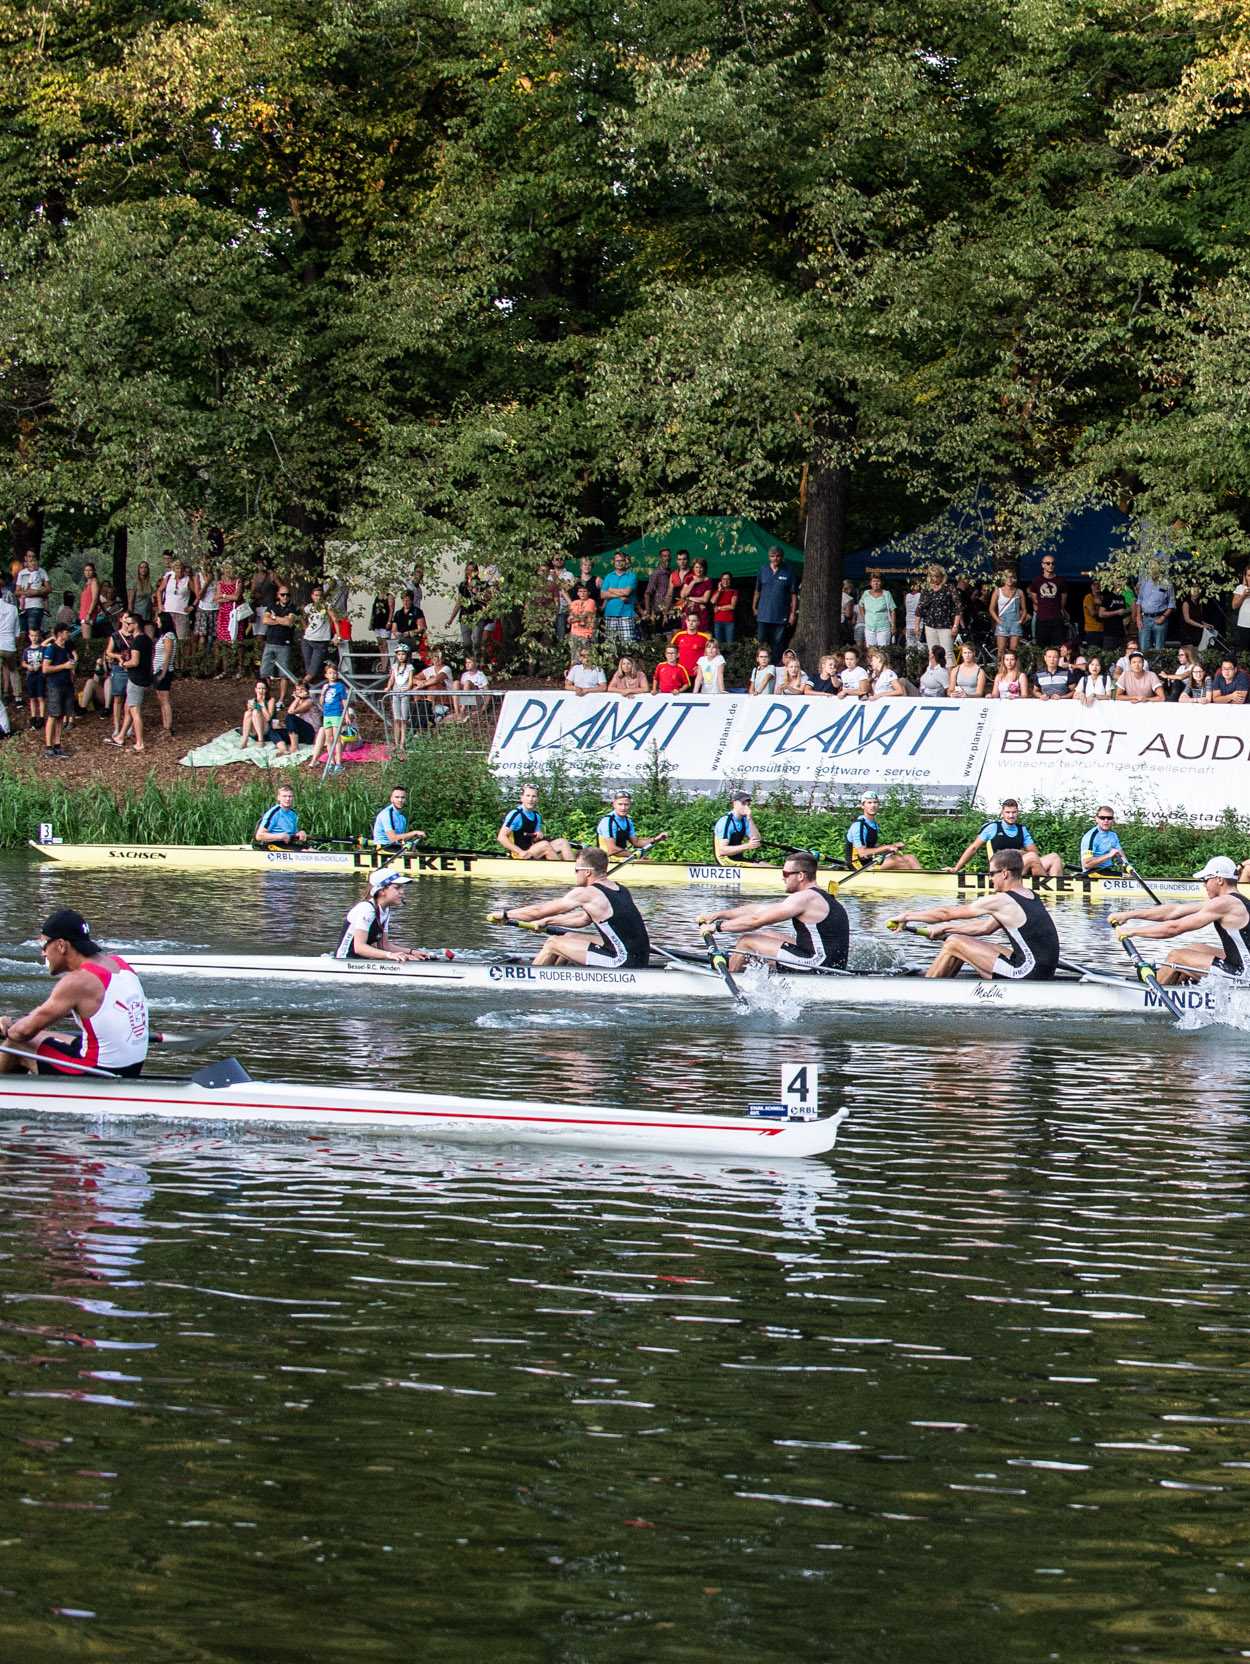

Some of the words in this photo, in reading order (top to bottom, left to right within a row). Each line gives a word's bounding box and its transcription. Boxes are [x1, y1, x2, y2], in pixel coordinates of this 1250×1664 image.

[500, 698, 711, 754] PLANAT
[742, 702, 961, 758] PLANAT
[711, 702, 738, 772] www.planat.de
[963, 706, 990, 777] www.planat.de
[1000, 729, 1127, 755] BEST
[497, 760, 557, 774] consultin
[737, 763, 801, 776] consulting
[815, 764, 870, 777] software
[884, 766, 931, 778] service
[44, 824, 51, 838] 3
[107, 850, 167, 860] SACHSEN
[276, 852, 294, 862] RBL
[689, 867, 742, 880] WURZEN
[958, 873, 1099, 893] LIKET
[1114, 880, 1135, 889] RBL
[1137, 882, 1200, 892] RDER-BUNDESLIGA
[380, 963, 401, 972] Minden
[506, 966, 536, 980] RBL
[540, 970, 637, 984] RUDER-BUNDESLIGA
[969, 981, 1005, 1000] Melitta
[1144, 990, 1231, 1010] MNDE
[787, 1066, 810, 1102] 4
